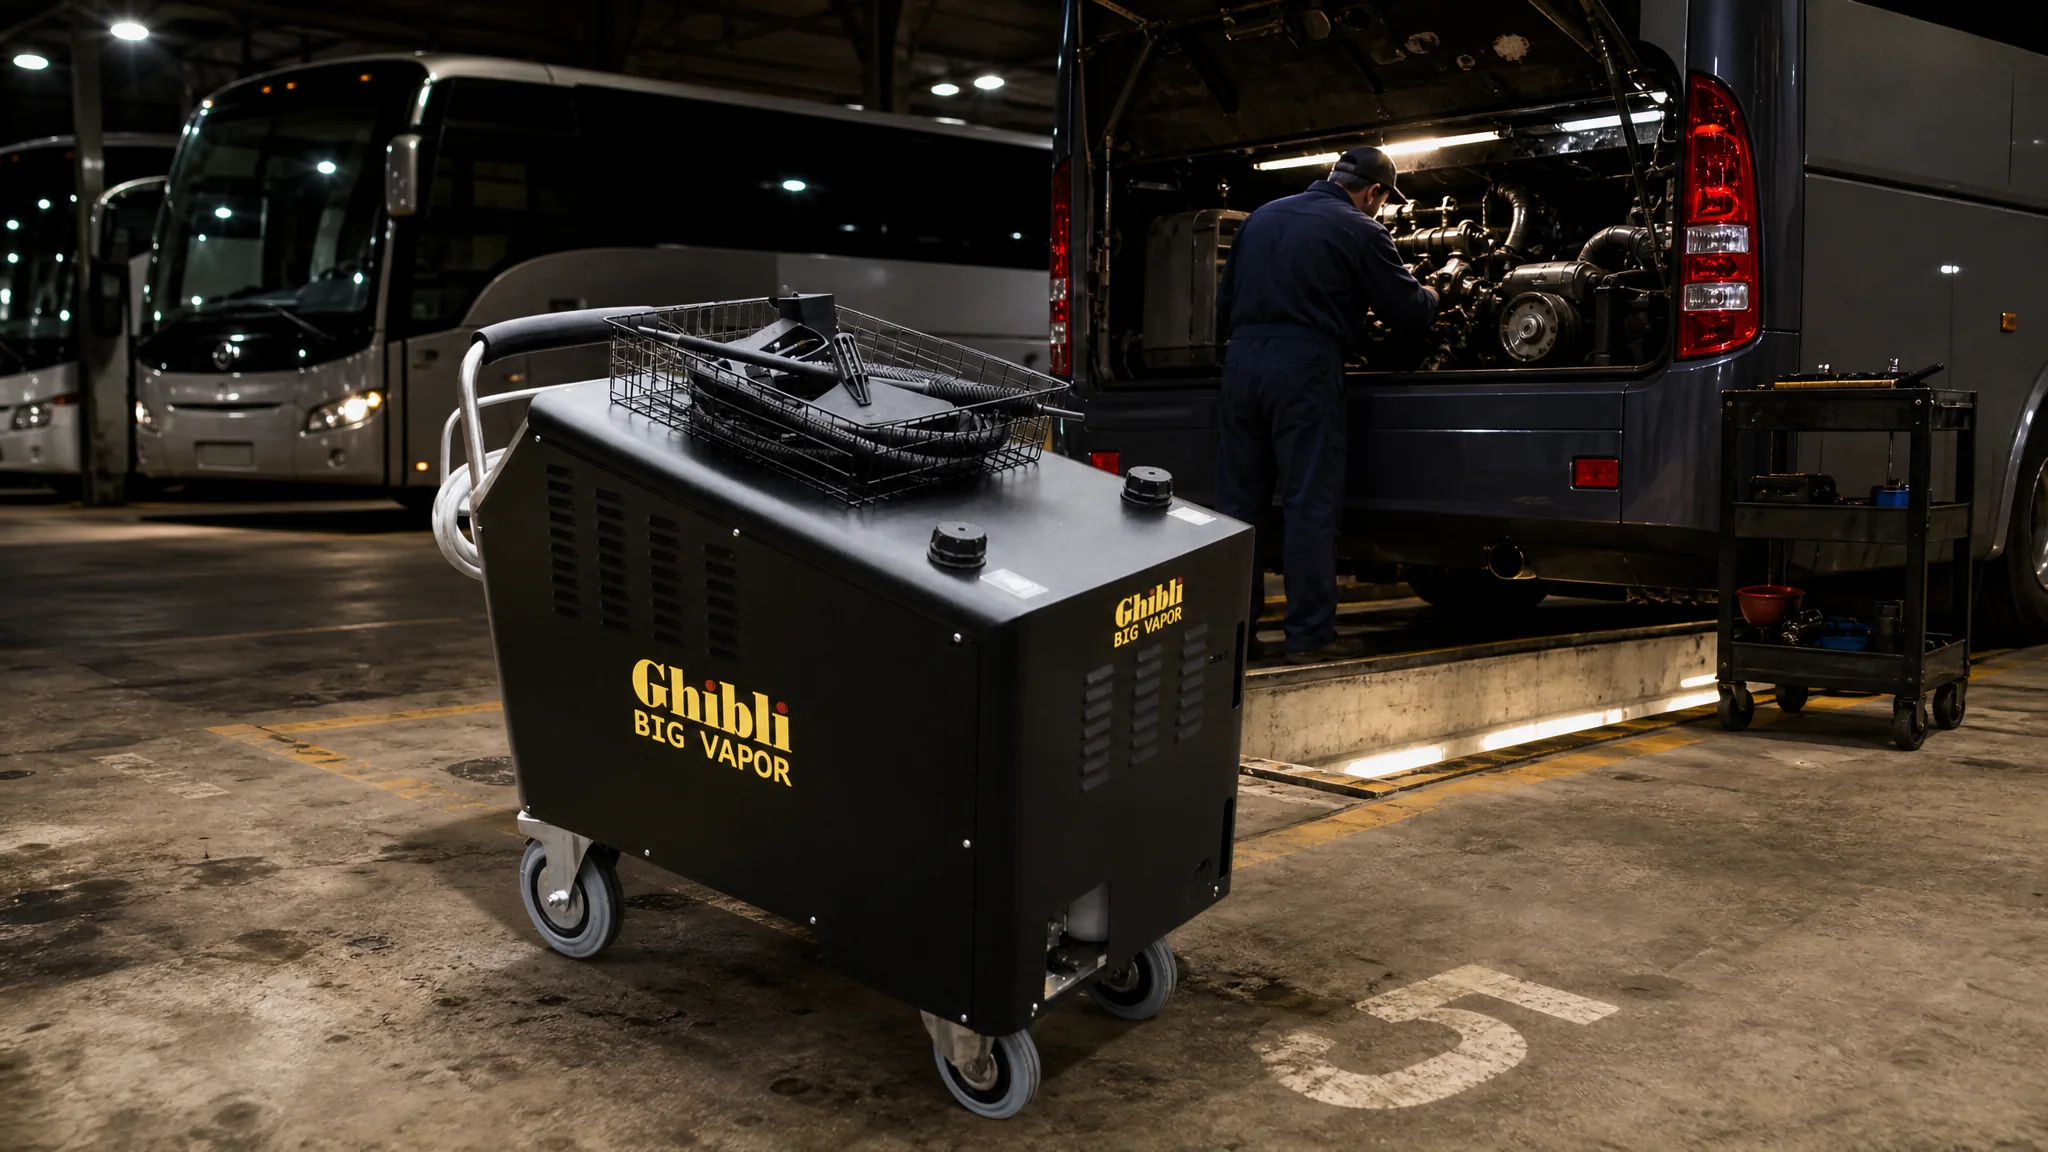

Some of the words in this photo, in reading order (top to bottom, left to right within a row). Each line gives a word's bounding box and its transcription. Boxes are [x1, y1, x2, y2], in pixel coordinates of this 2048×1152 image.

[1114, 624, 1139, 648] BIG
[1144, 607, 1183, 634] VAPOR
[1115, 577, 1183, 628] Ghibli
[632, 658, 792, 754] Ghibli
[634, 709, 685, 749] BIG
[700, 730, 792, 787] VAPOR
[1259, 964, 1621, 1110] 5
